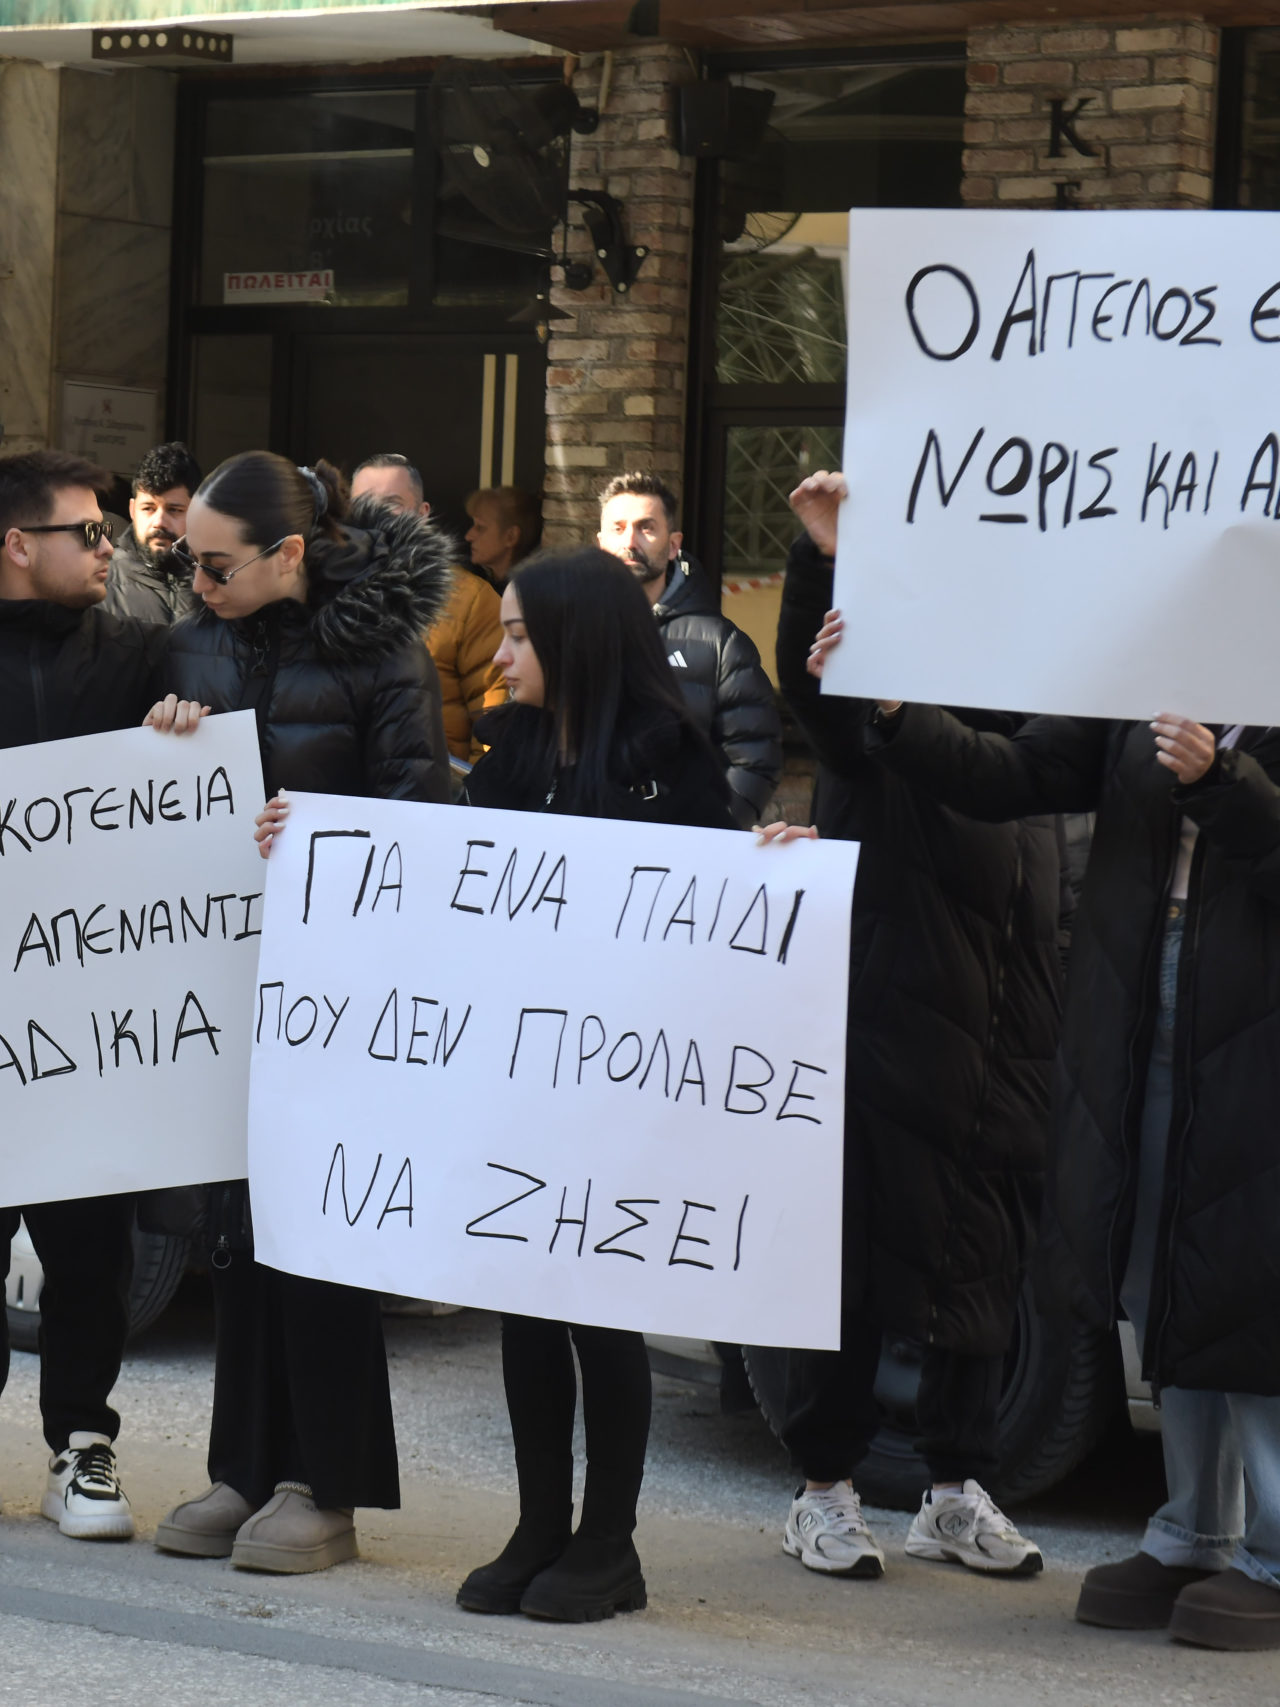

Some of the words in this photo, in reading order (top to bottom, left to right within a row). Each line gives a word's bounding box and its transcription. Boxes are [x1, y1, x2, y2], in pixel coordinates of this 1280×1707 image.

[228, 273, 332, 290] ΠΩΛΕΙΤΑΙ
[905, 263, 980, 361] Ο
[990, 248, 1223, 361] ΑΓΓΕΛΟΣ
[906, 427, 1119, 532] ΝΩΡΙΣ
[1140, 441, 1219, 530] ΚΑΙ
[1239, 431, 1280, 520] Α
[14, 893, 264, 972] ΑΠΕΝΑΝΤΙ
[302, 829, 404, 925] ΓΙΑ
[450, 840, 568, 932] ΕΝΑ
[615, 866, 806, 965] ΠΑΙΔΙ
[256, 981, 350, 1049] ΠΟΥ
[367, 987, 472, 1066] ΔΕΝ
[508, 1007, 829, 1125] ΠΡΟΛΑΒΕ
[322, 1142, 414, 1230] ΝΑ
[465, 1162, 750, 1271] ΖΗΣΕΙ
